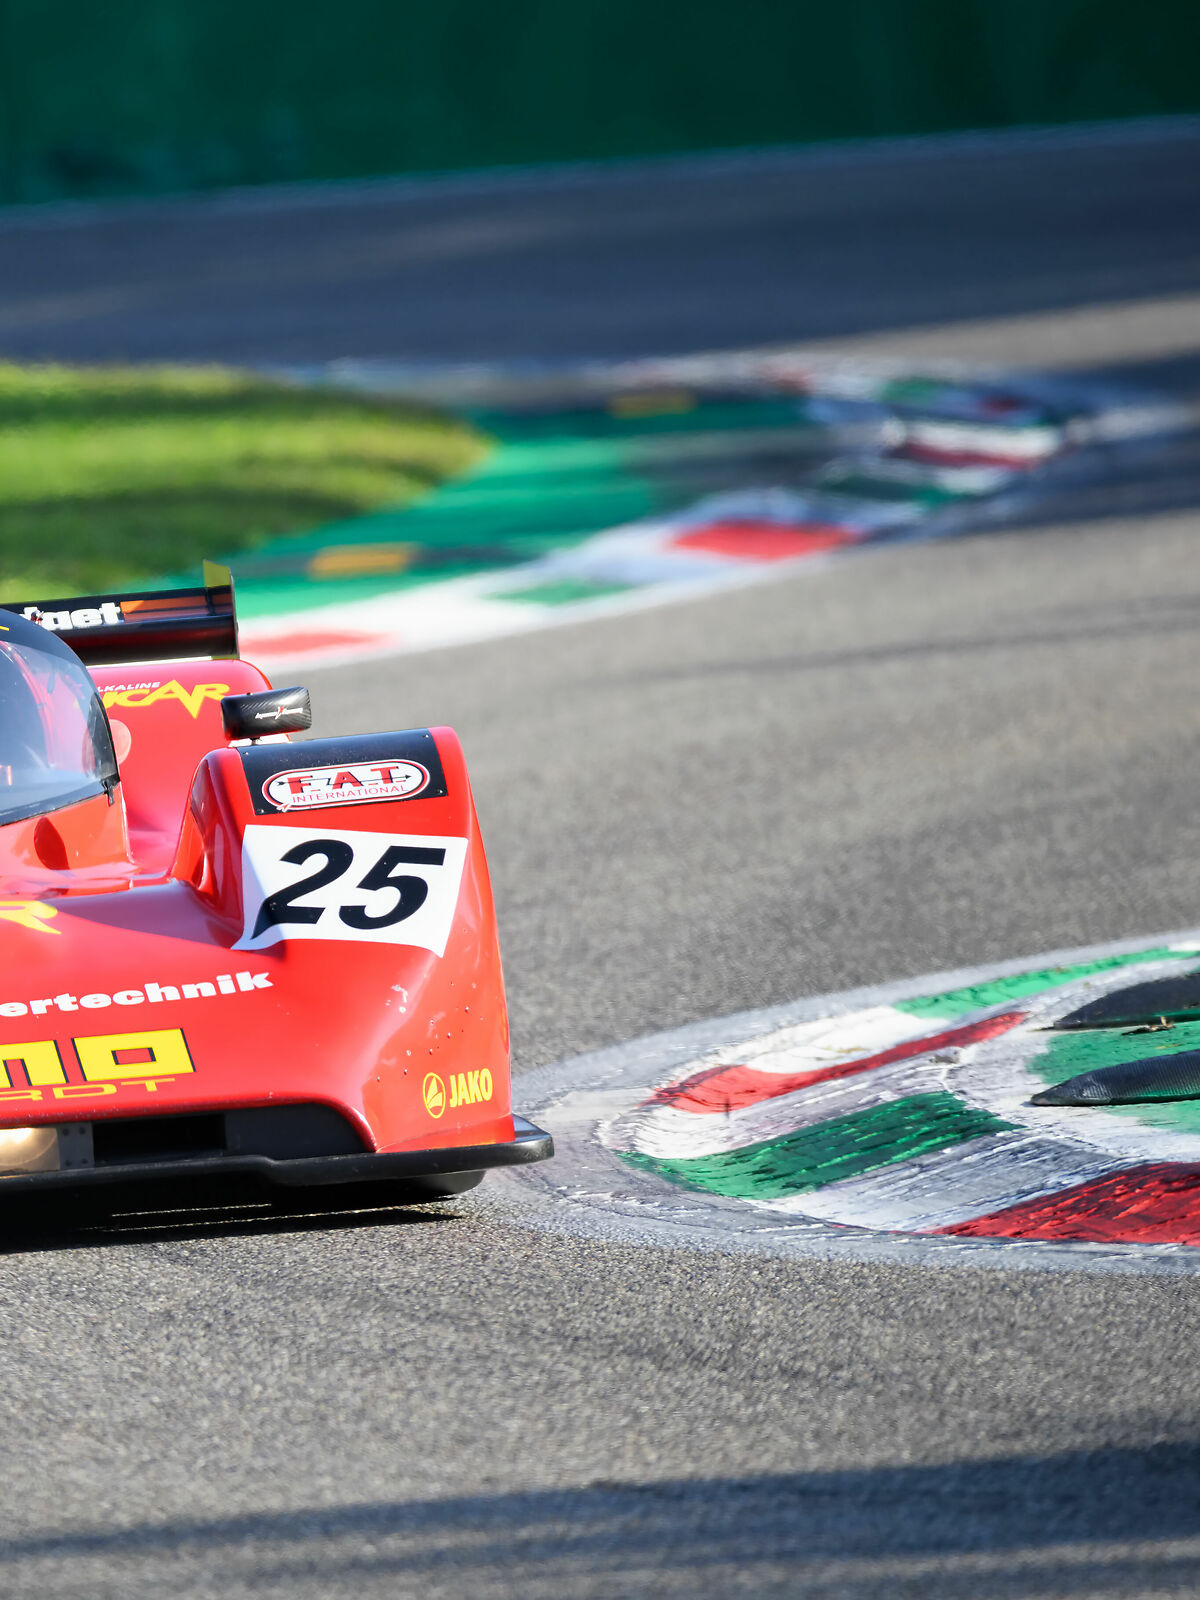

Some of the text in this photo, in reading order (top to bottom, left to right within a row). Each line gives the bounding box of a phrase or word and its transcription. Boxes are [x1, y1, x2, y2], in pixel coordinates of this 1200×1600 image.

[97, 682, 161, 692] LKALINE
[286, 765, 407, 795] F.A.T.
[292, 784, 409, 803] INTERNATIONAL
[250, 838, 447, 940] 25
[449, 1067, 493, 1108] JAKO
